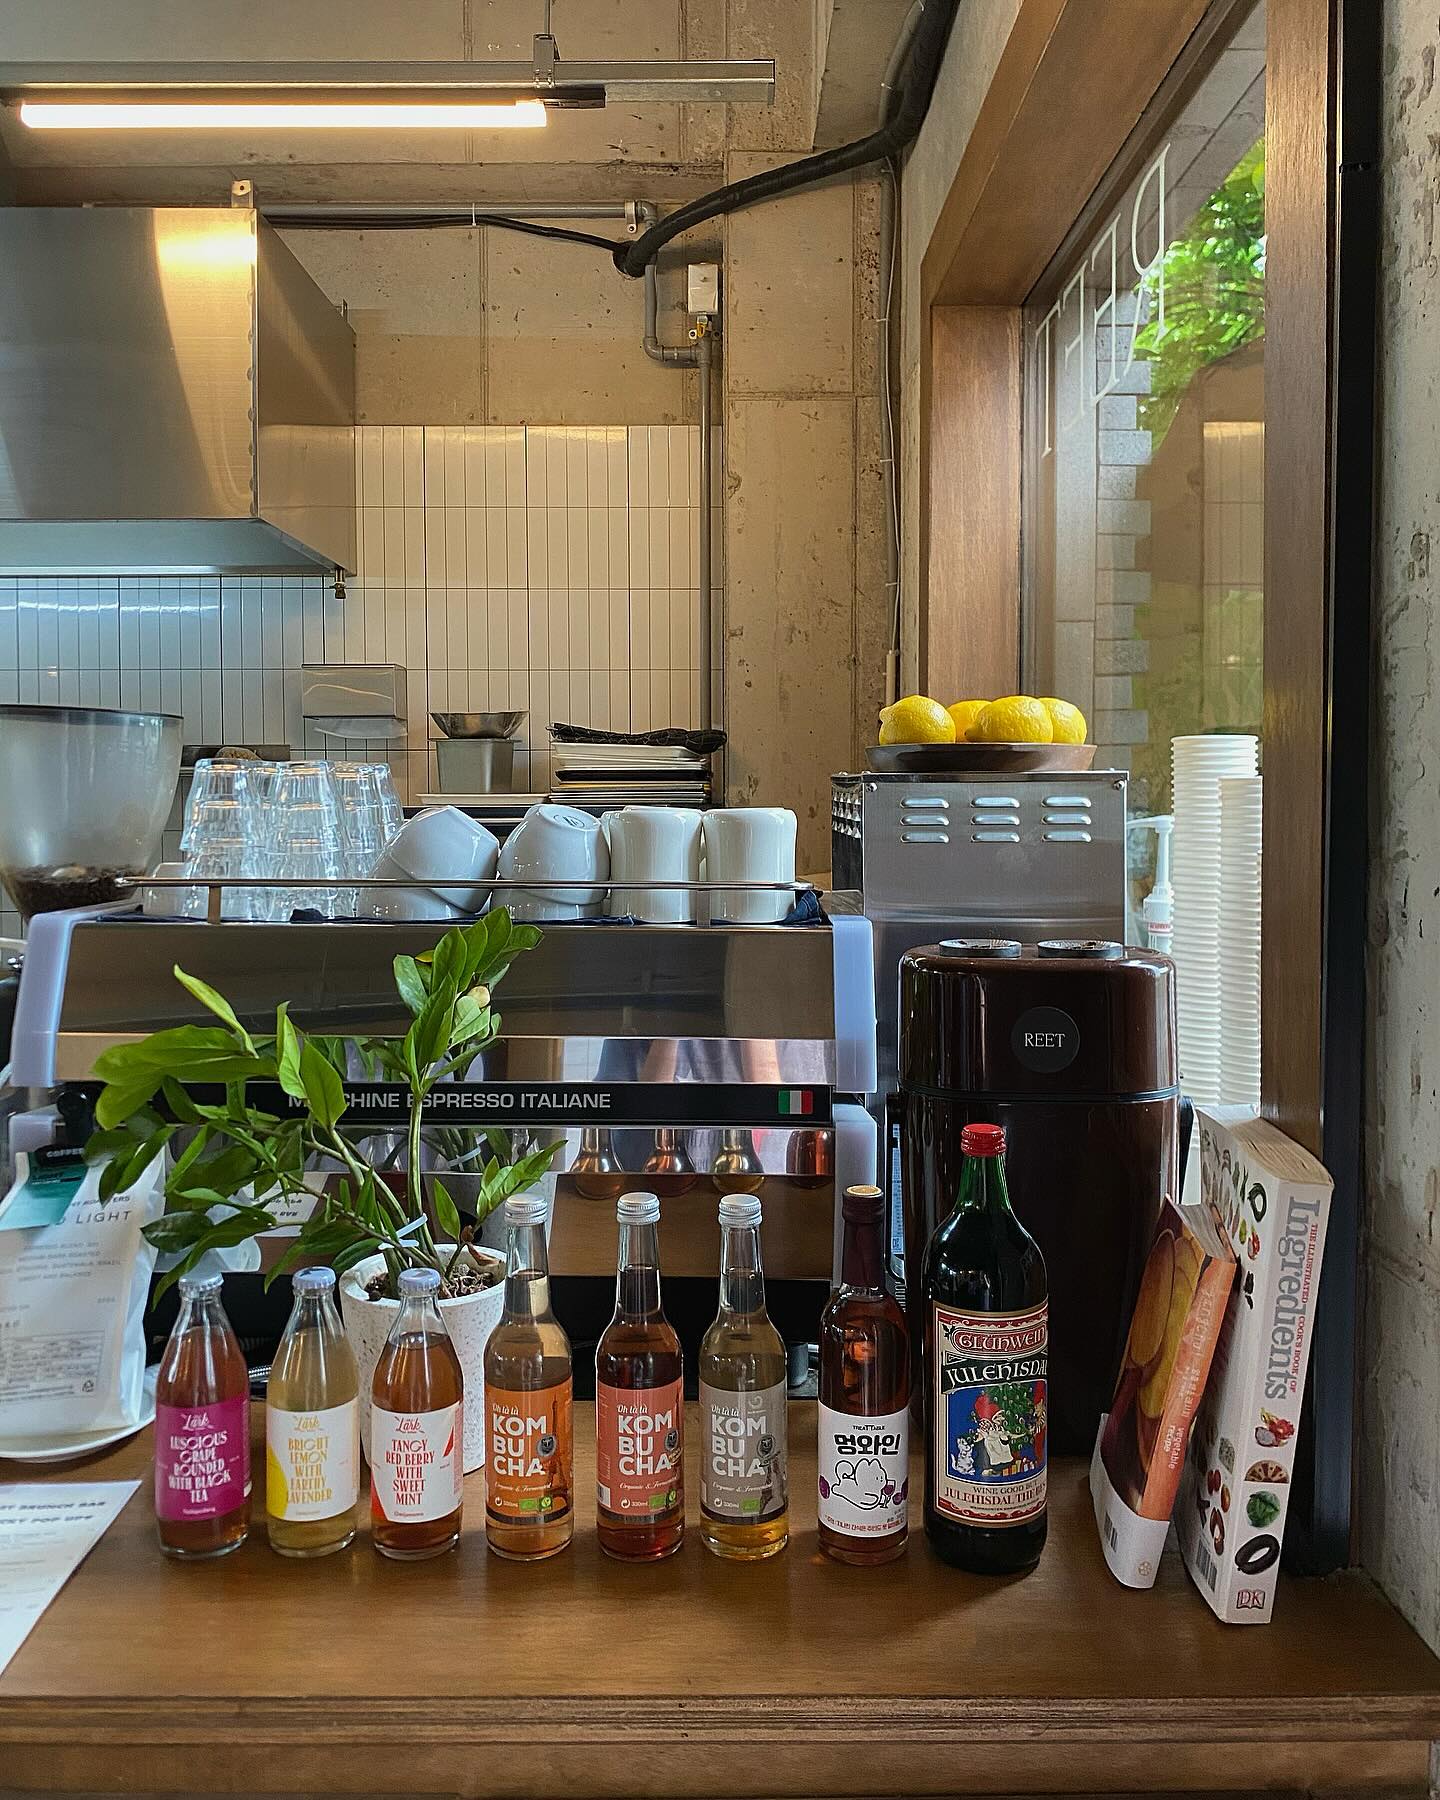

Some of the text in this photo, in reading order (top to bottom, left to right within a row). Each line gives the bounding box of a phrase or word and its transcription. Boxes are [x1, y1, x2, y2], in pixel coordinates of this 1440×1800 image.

[1024, 1032, 1066, 1048] REET
[288, 1093, 400, 1108] MCHINE
[521, 1093, 611, 1108] ITALIANE
[76, 1210, 132, 1224] LIGHT
[1263, 1196, 1321, 1401] Ingredients
[1289, 1223, 1319, 1393] THE ILLUSTRATED COOK'S BOOK OF
[183, 1412, 209, 1431] Lark
[395, 1417, 421, 1433] Lark
[493, 1413, 547, 1436] KOM
[618, 1410, 672, 1435] KOM
[711, 1413, 767, 1437] KOM
[170, 1430, 228, 1450] LUSCIOUS
[288, 1436, 330, 1451] BRIGHT
[392, 1439, 428, 1452] TANGY
[493, 1434, 524, 1457] BU
[618, 1436, 654, 1456] BU
[712, 1435, 745, 1459] BU
[834, 1433, 901, 1456] 멍와인
[1162, 1424, 1176, 1453] recipe
[1168, 1426, 1186, 1470] vegetable
[180, 1447, 216, 1464] GRAPE
[290, 1451, 327, 1464] LEMON
[385, 1451, 435, 1465] RED BERRY
[619, 1453, 672, 1476] CHA
[295, 1464, 322, 1477] WITH
[396, 1466, 422, 1479] WITH
[493, 1455, 546, 1477] CHA
[713, 1456, 766, 1478] CHA
[168, 1469, 231, 1490] WITH BLACK
[393, 1479, 426, 1492] SWEET
[190, 1488, 208, 1503] TEA
[396, 1492, 422, 1505] MINT
[945, 1486, 1015, 1505] JULEHISDAL
[973, 1486, 998, 1495] WINE
[1240, 1590, 1262, 1606] DK
